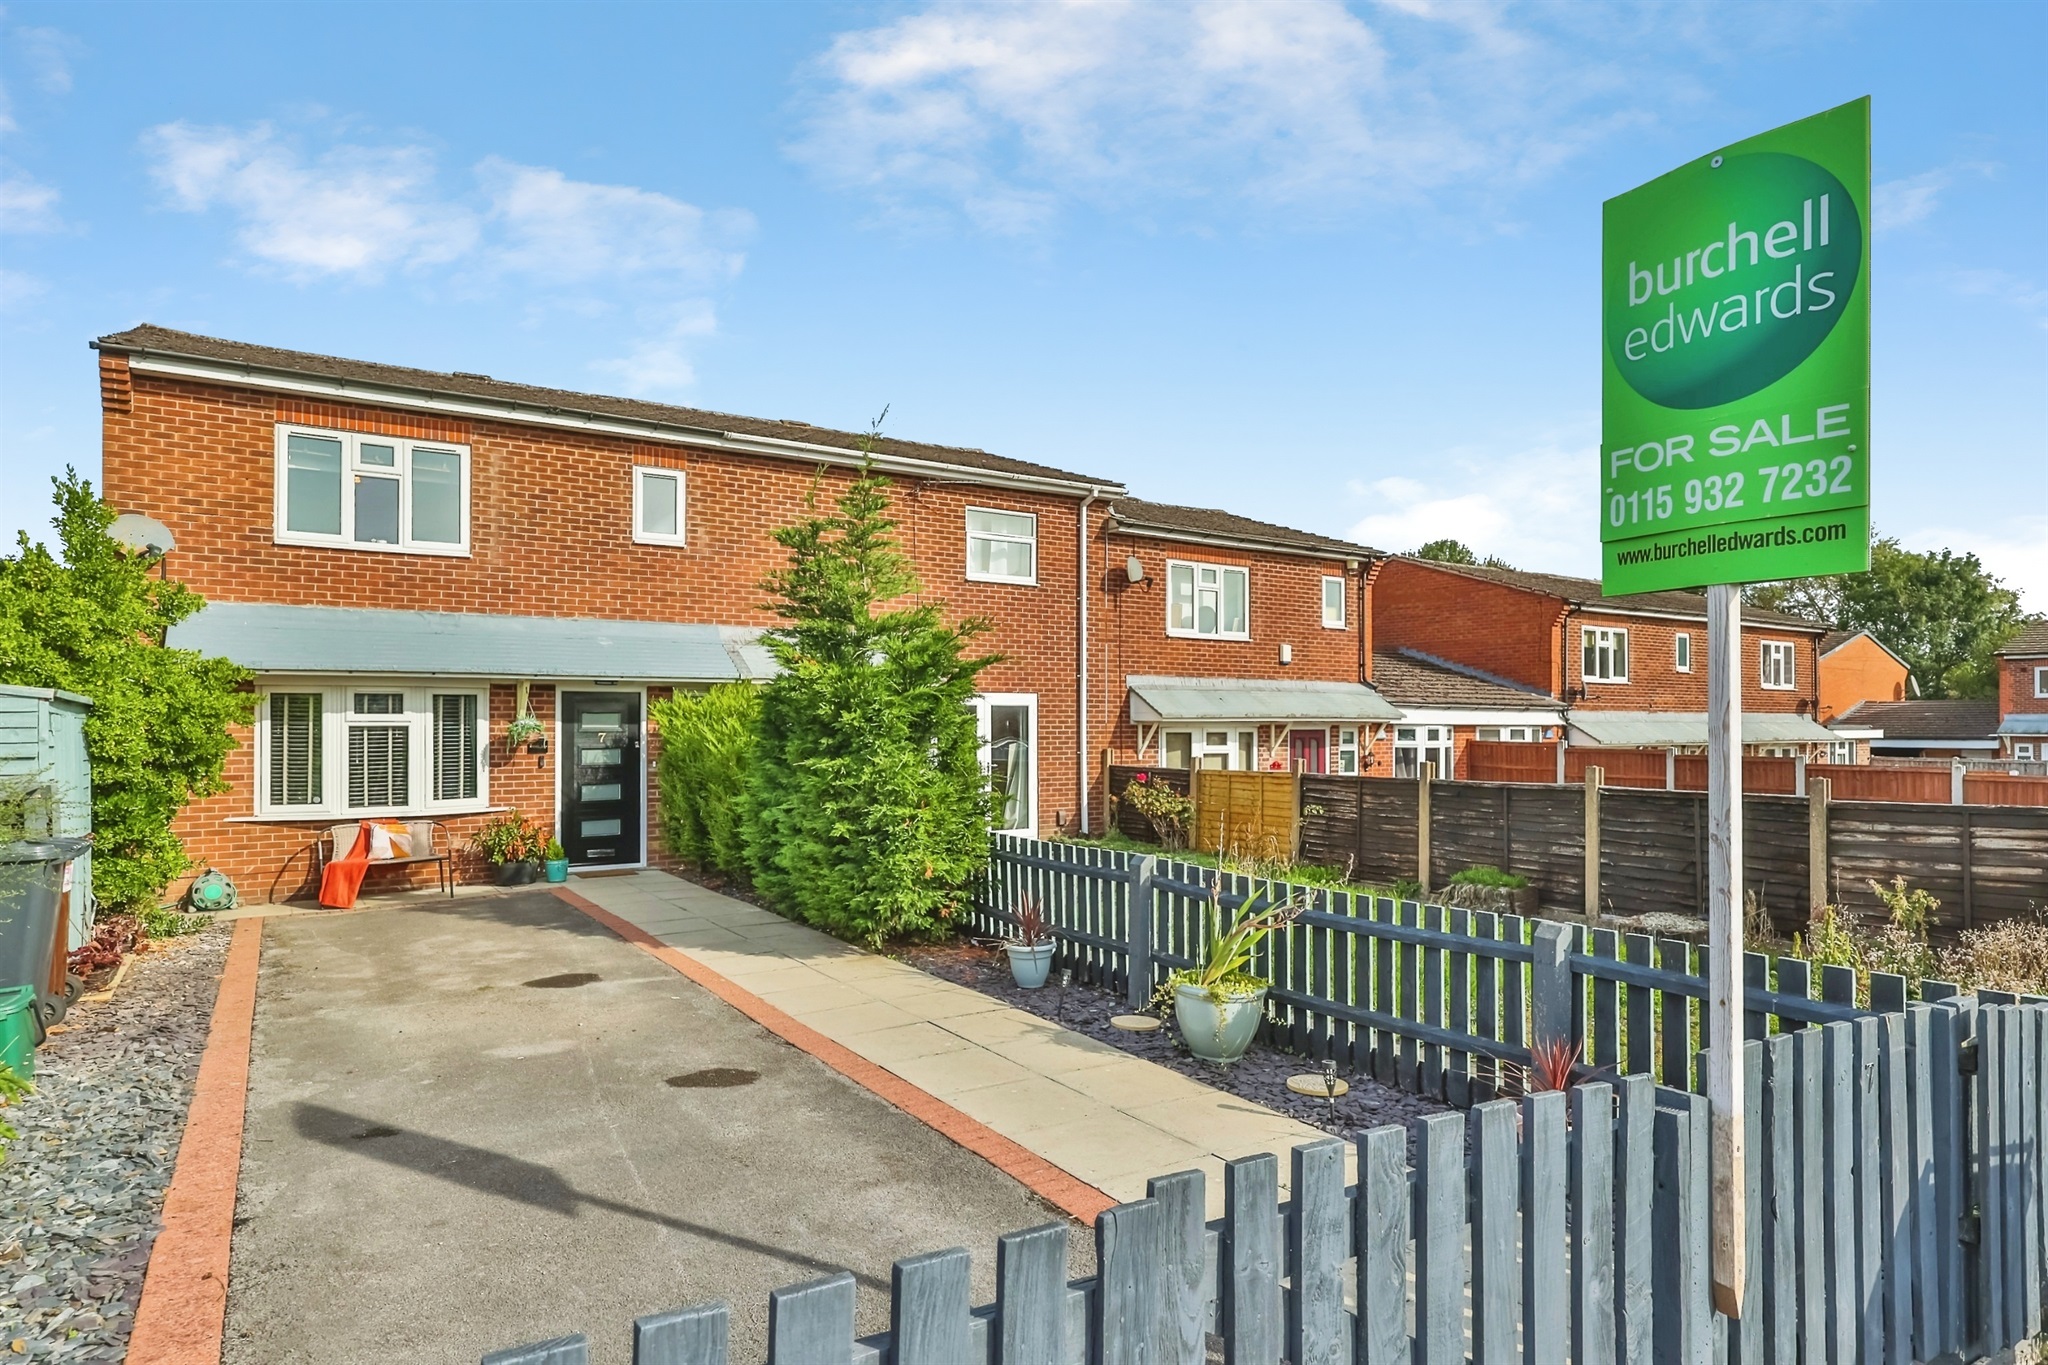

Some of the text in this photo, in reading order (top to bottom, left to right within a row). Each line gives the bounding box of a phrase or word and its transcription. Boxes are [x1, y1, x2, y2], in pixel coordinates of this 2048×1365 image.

[1628, 194, 1829, 307] burchell
[1624, 264, 1836, 361] edwards
[1611, 404, 1850, 479] FOR SALE
[1610, 455, 1852, 527] 0115 932 7232
[1617, 522, 1847, 566] www.burchelledwards.com
[598, 732, 607, 743] 7
